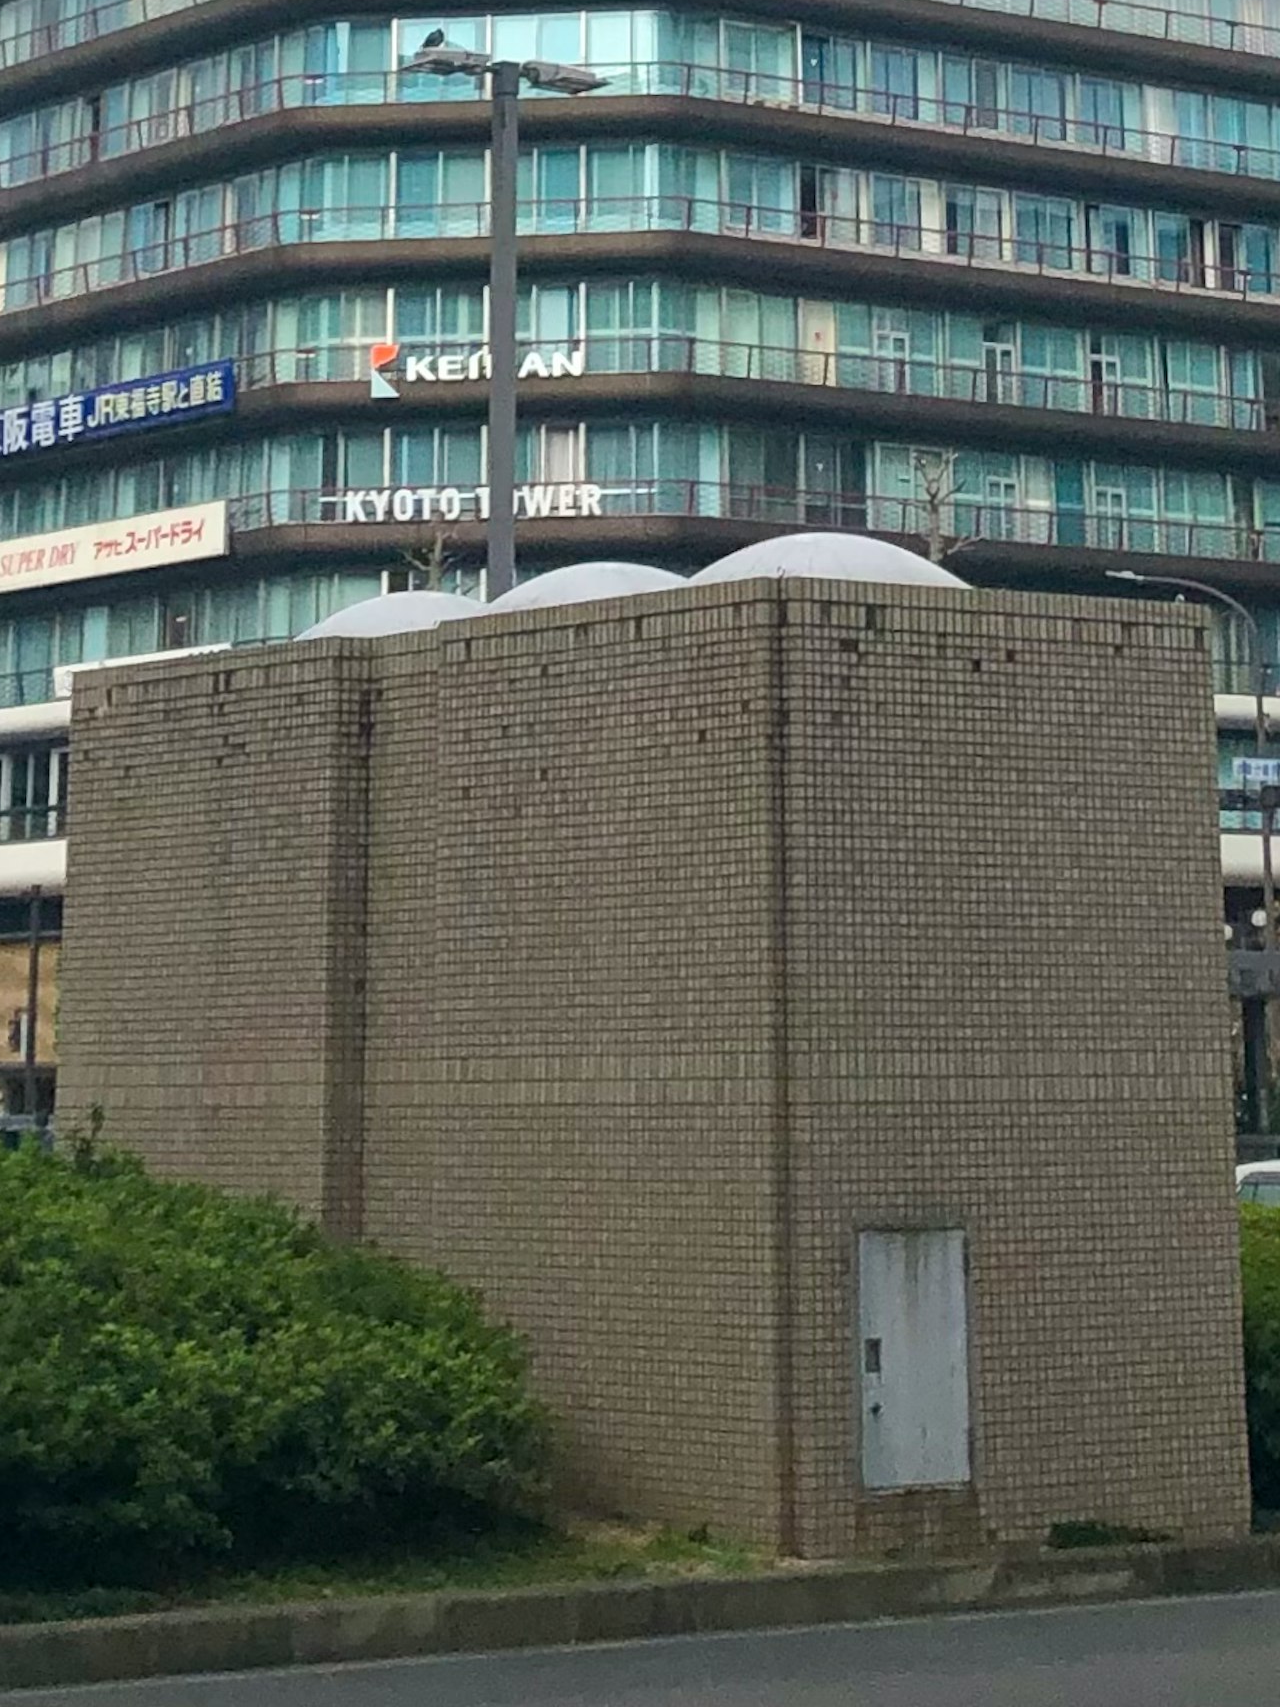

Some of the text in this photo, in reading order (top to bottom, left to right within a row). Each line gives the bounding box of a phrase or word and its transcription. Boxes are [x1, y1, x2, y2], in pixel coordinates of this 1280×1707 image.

[405, 350, 585, 382] KEIAN
[345, 483, 602, 523] KYOTO TWER
[48, 541, 78, 569] DRY
